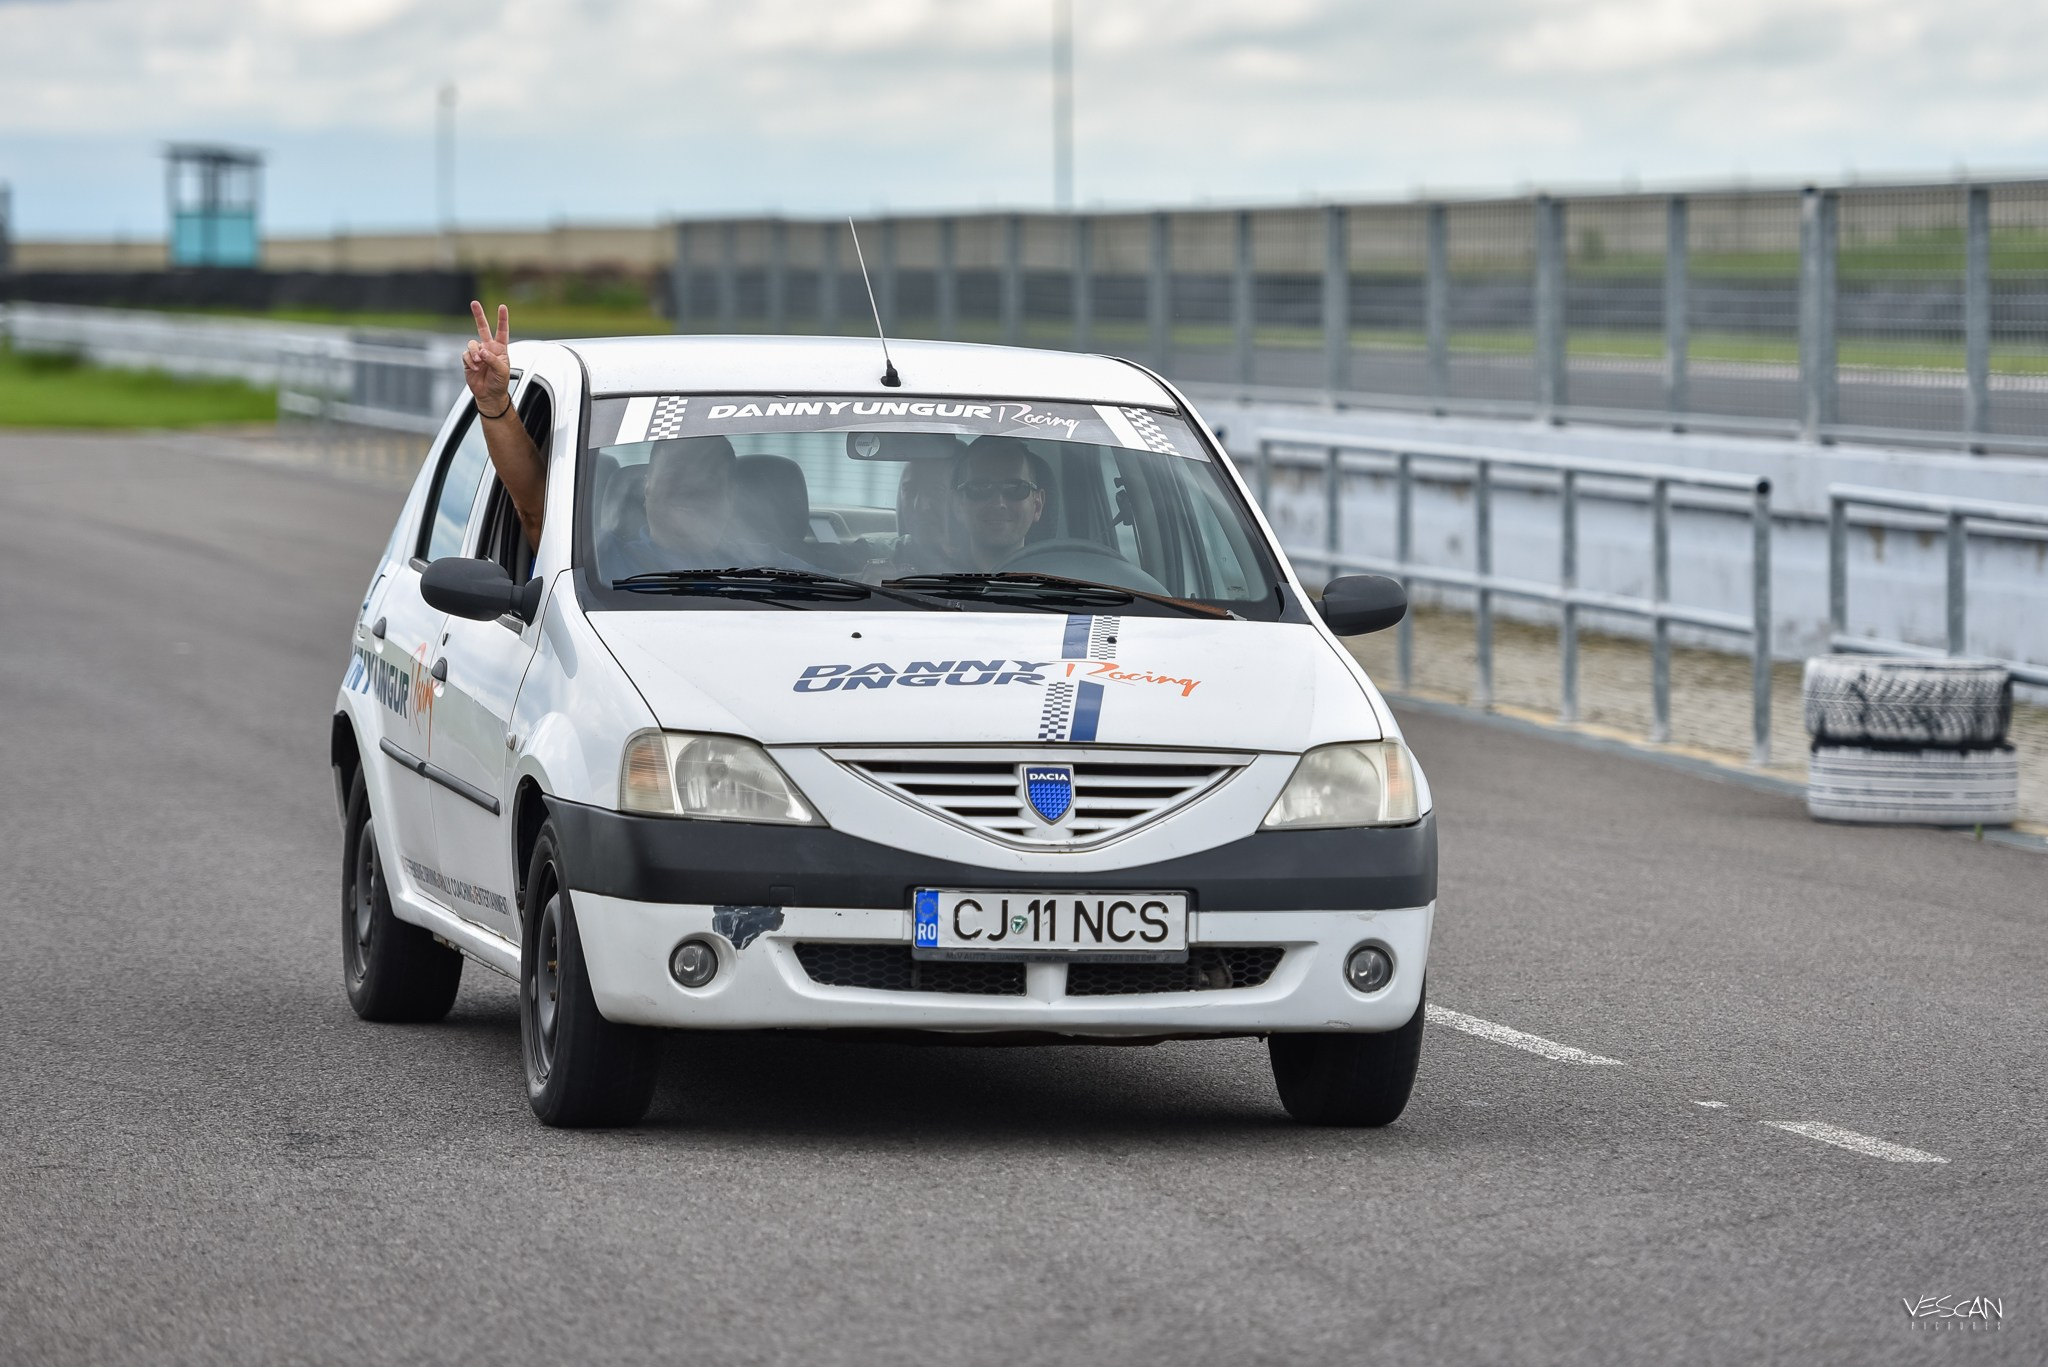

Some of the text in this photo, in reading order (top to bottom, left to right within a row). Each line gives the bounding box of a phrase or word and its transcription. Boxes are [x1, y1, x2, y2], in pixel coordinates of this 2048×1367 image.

[793, 671, 1047, 693] UNGUR
[799, 660, 1202, 697] DANNY Racing
[1028, 772, 1069, 782] DACIA
[917, 899, 1170, 943] RO CJ 11 NCS
